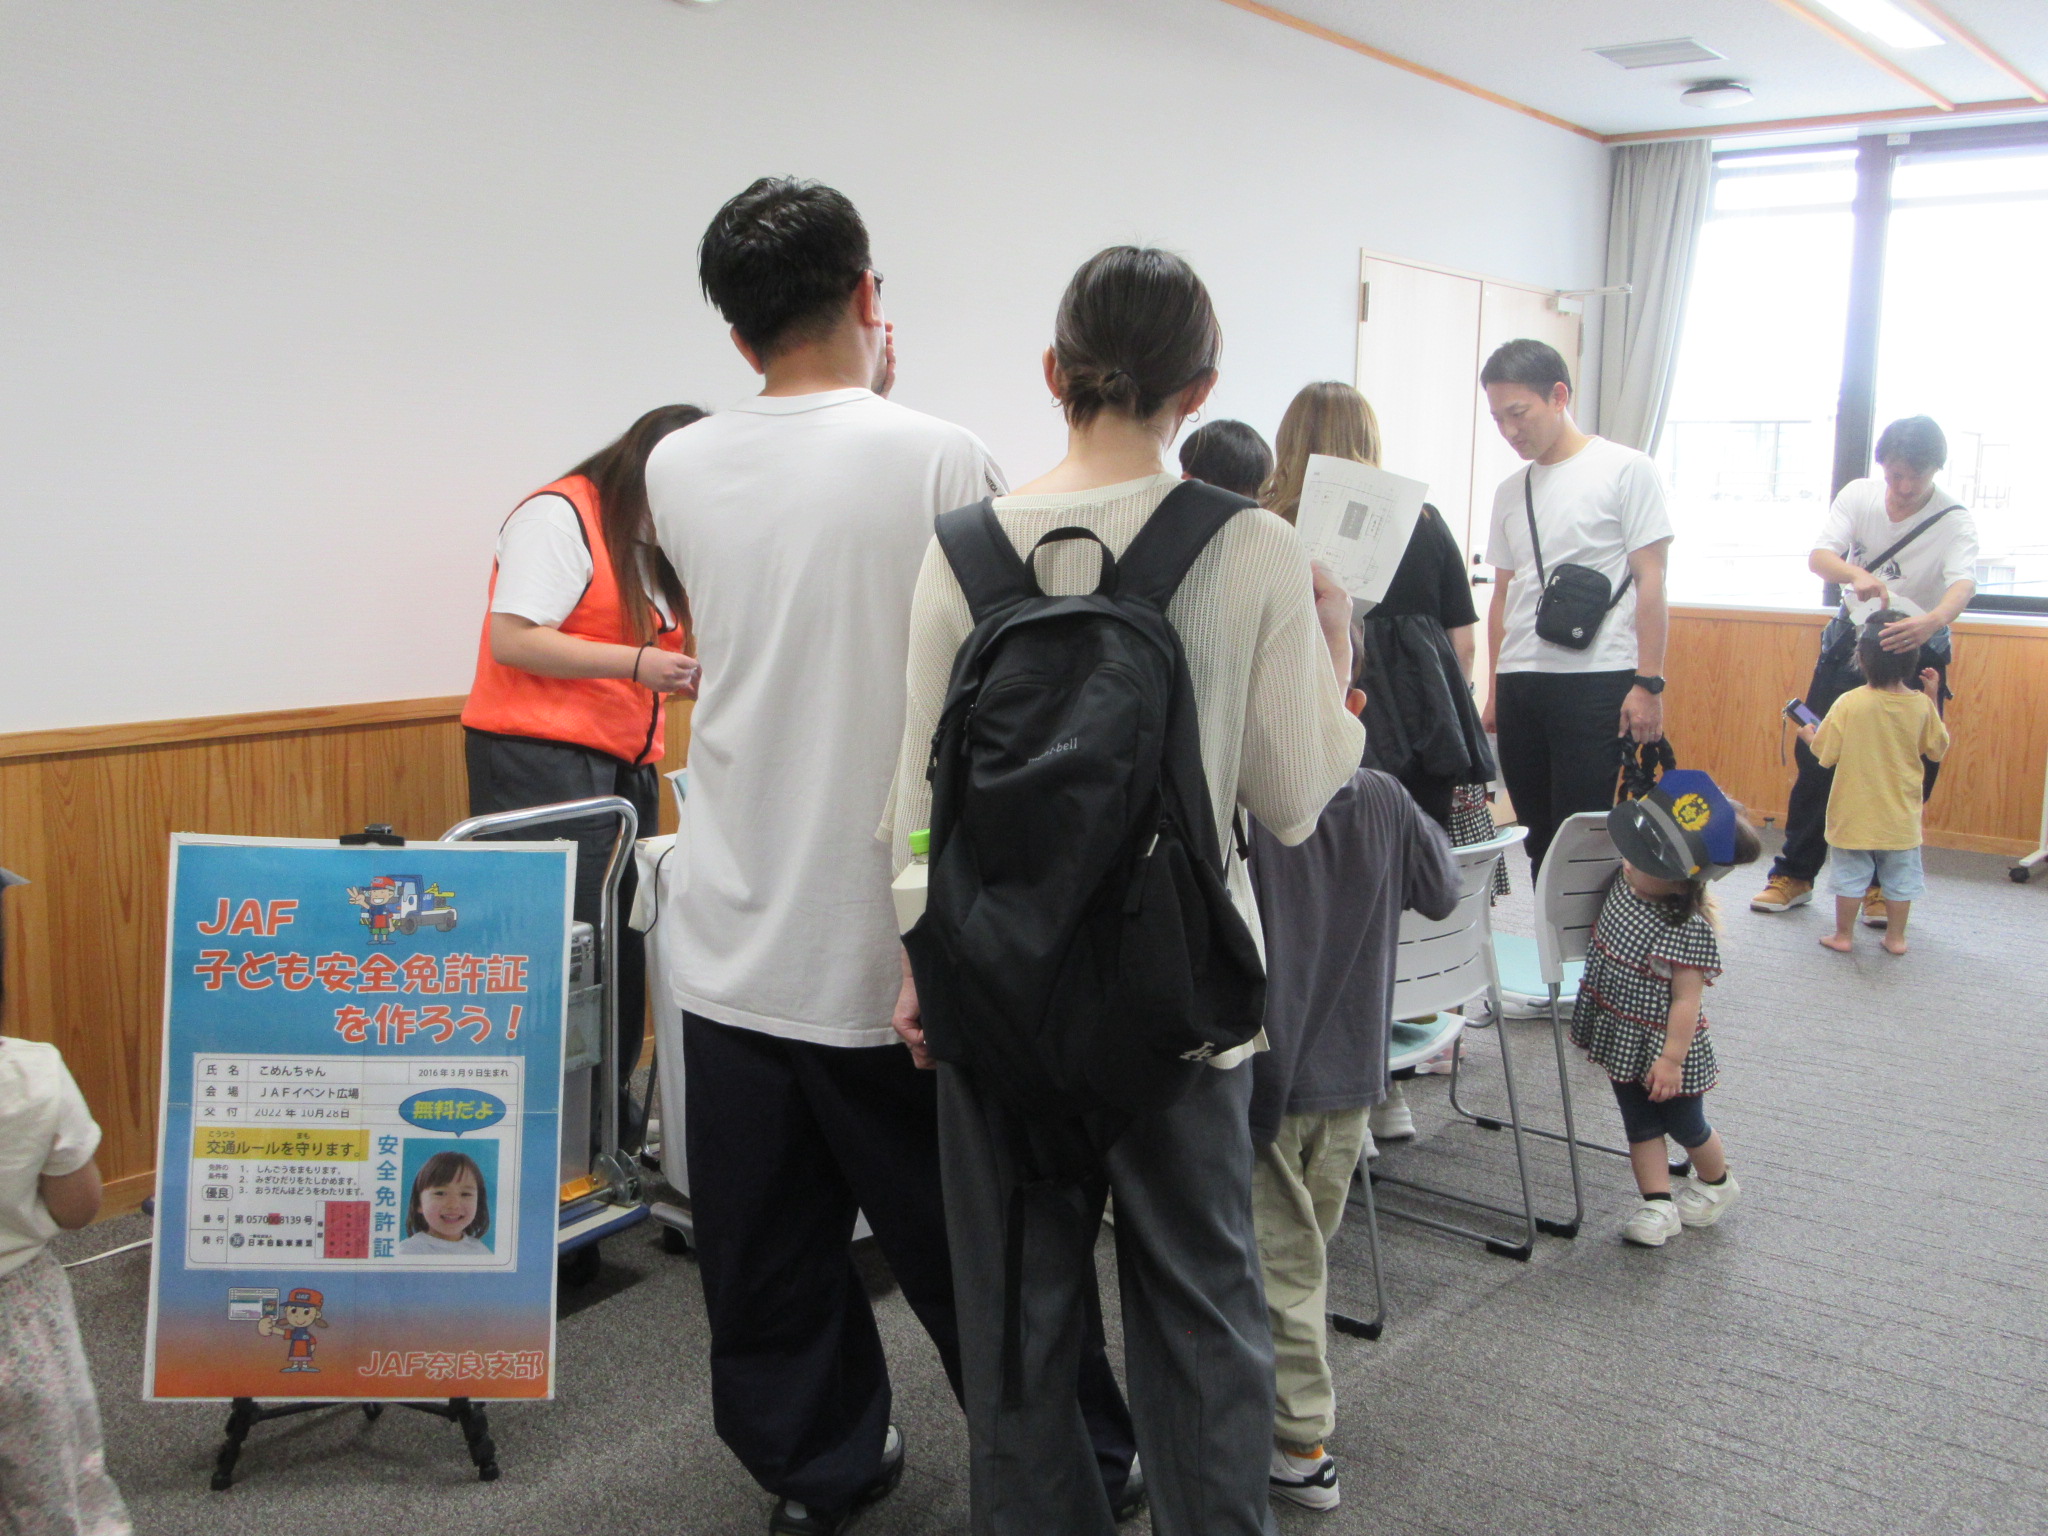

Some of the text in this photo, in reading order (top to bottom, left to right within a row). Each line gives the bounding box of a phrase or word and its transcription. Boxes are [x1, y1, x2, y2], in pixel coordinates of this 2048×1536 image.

[197, 898, 298, 936] JAF
[194, 949, 528, 994] 子ども安全免許証
[260, 1066, 326, 1077] こめんちゃん
[413, 1100, 494, 1120] 無料だよ
[207, 1140, 360, 1158] 交通ルールを守ります。
[205, 1187, 229, 1199] 優良
[373, 1134, 399, 1258] 安全免許証
[202, 1235, 225, 1245] 発行
[359, 1350, 544, 1380] JAF奈良支部
